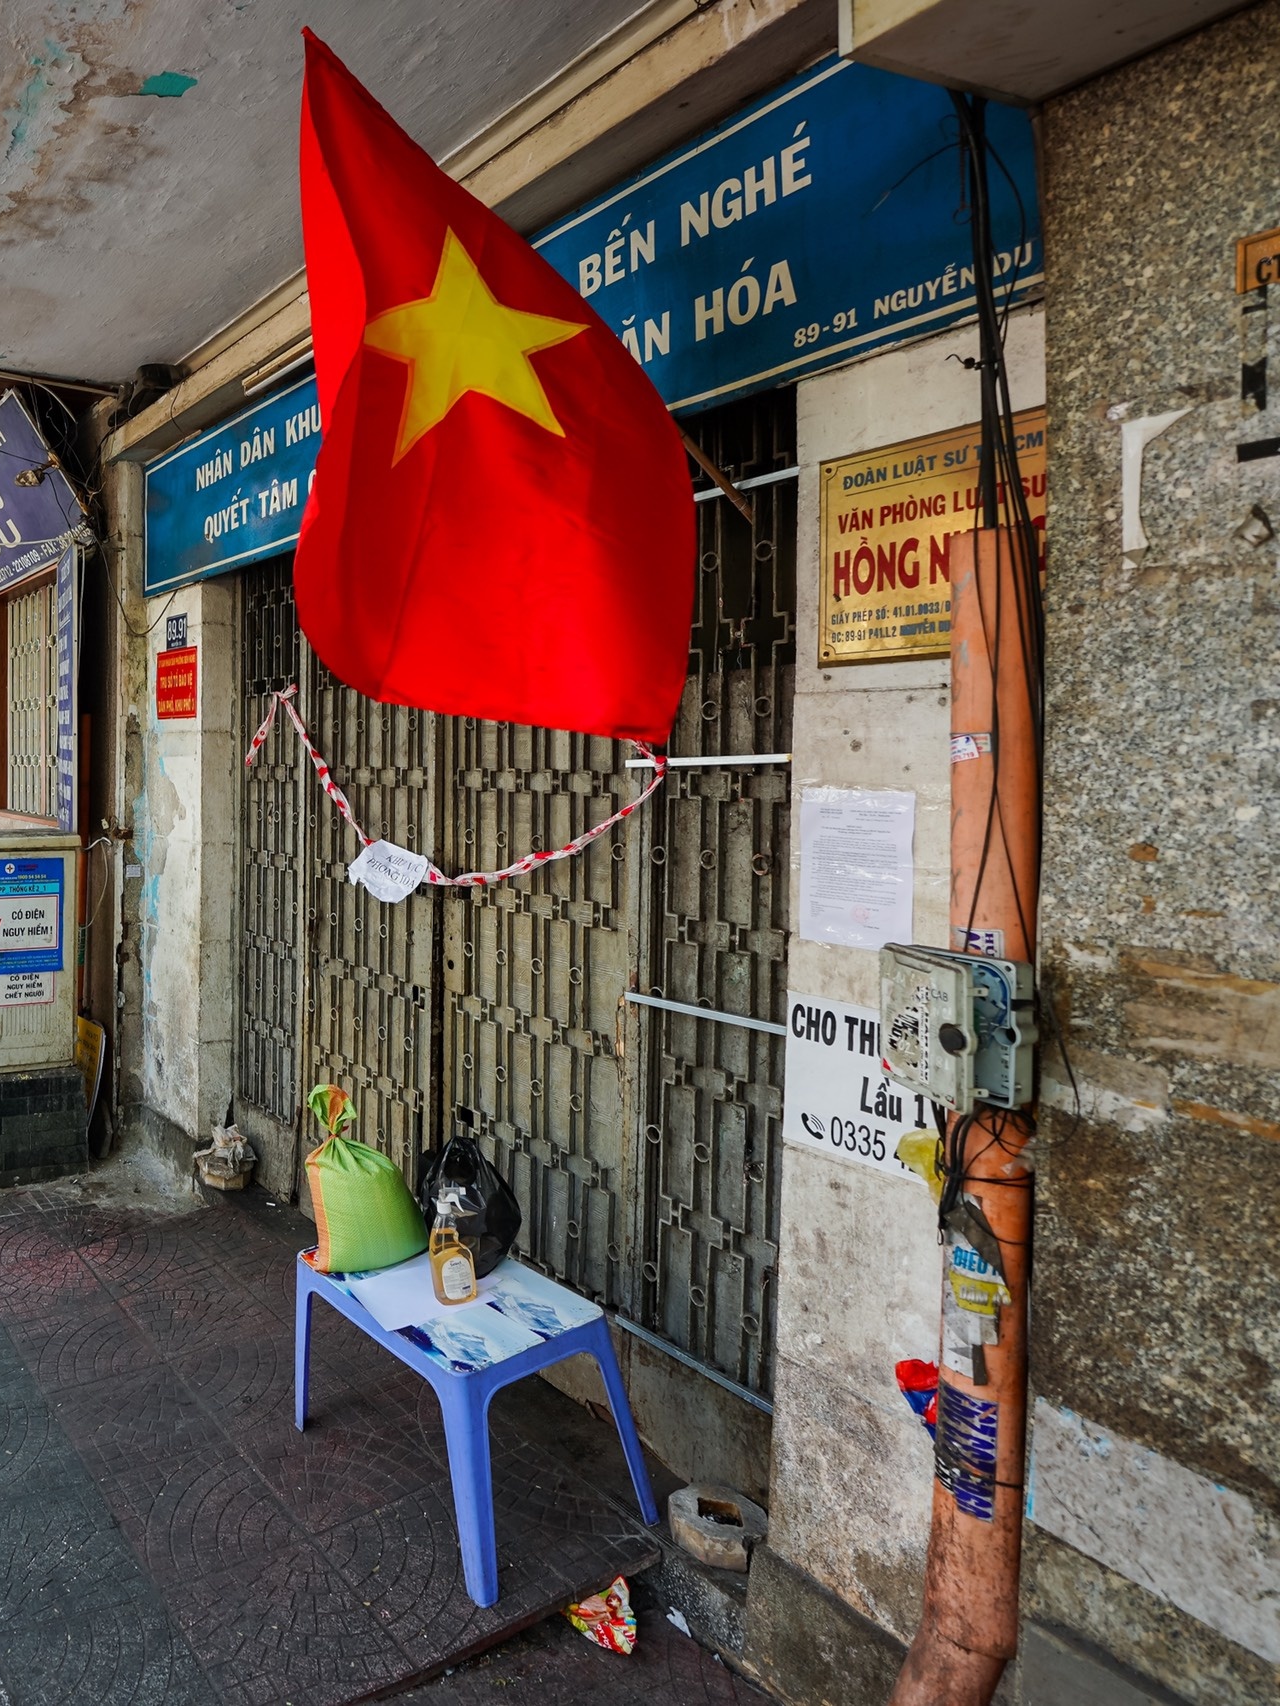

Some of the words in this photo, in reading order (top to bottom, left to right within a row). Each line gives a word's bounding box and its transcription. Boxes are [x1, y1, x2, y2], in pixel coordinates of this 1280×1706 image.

[578, 213, 656, 299] BẾN
[680, 120, 813, 247] NGHÉ
[618, 311, 671, 366] ĂN
[694, 257, 798, 342] HÓA
[793, 308, 858, 349] 89-91
[874, 264, 977, 320] NGUYỄN
[196, 449, 233, 491] NHÂN
[240, 426, 275, 470] DÂN
[286, 402, 322, 447] KHU
[843, 467, 887, 490] ĐOÀN
[893, 455, 937, 479] LUẬT
[943, 443, 970, 466] SƯ
[204, 488, 250, 544] QUYẾT
[259, 478, 298, 519] TÂM
[838, 507, 873, 534] VĂN
[880, 494, 946, 526] PHÒNG
[954, 480, 1009, 513] LUT
[834, 536, 920, 598] HỒNG
[831, 607, 850, 626] GIẤY
[852, 608, 873, 623] PHÉP
[875, 604, 890, 621] SỐ:
[2, 927, 26, 937] NGUY
[11, 908, 23, 920] CÓ
[25, 908, 45, 920] ĐIỆN
[4, 991, 22, 999] CHẾT
[26, 980, 43, 989] HIỂM
[792, 1003, 837, 1046] CHO
[844, 1015, 881, 1058] TH
[860, 1076, 903, 1123] Lầu
[914, 1093, 927, 1129] 1
[831, 1115, 886, 1162] 0335
